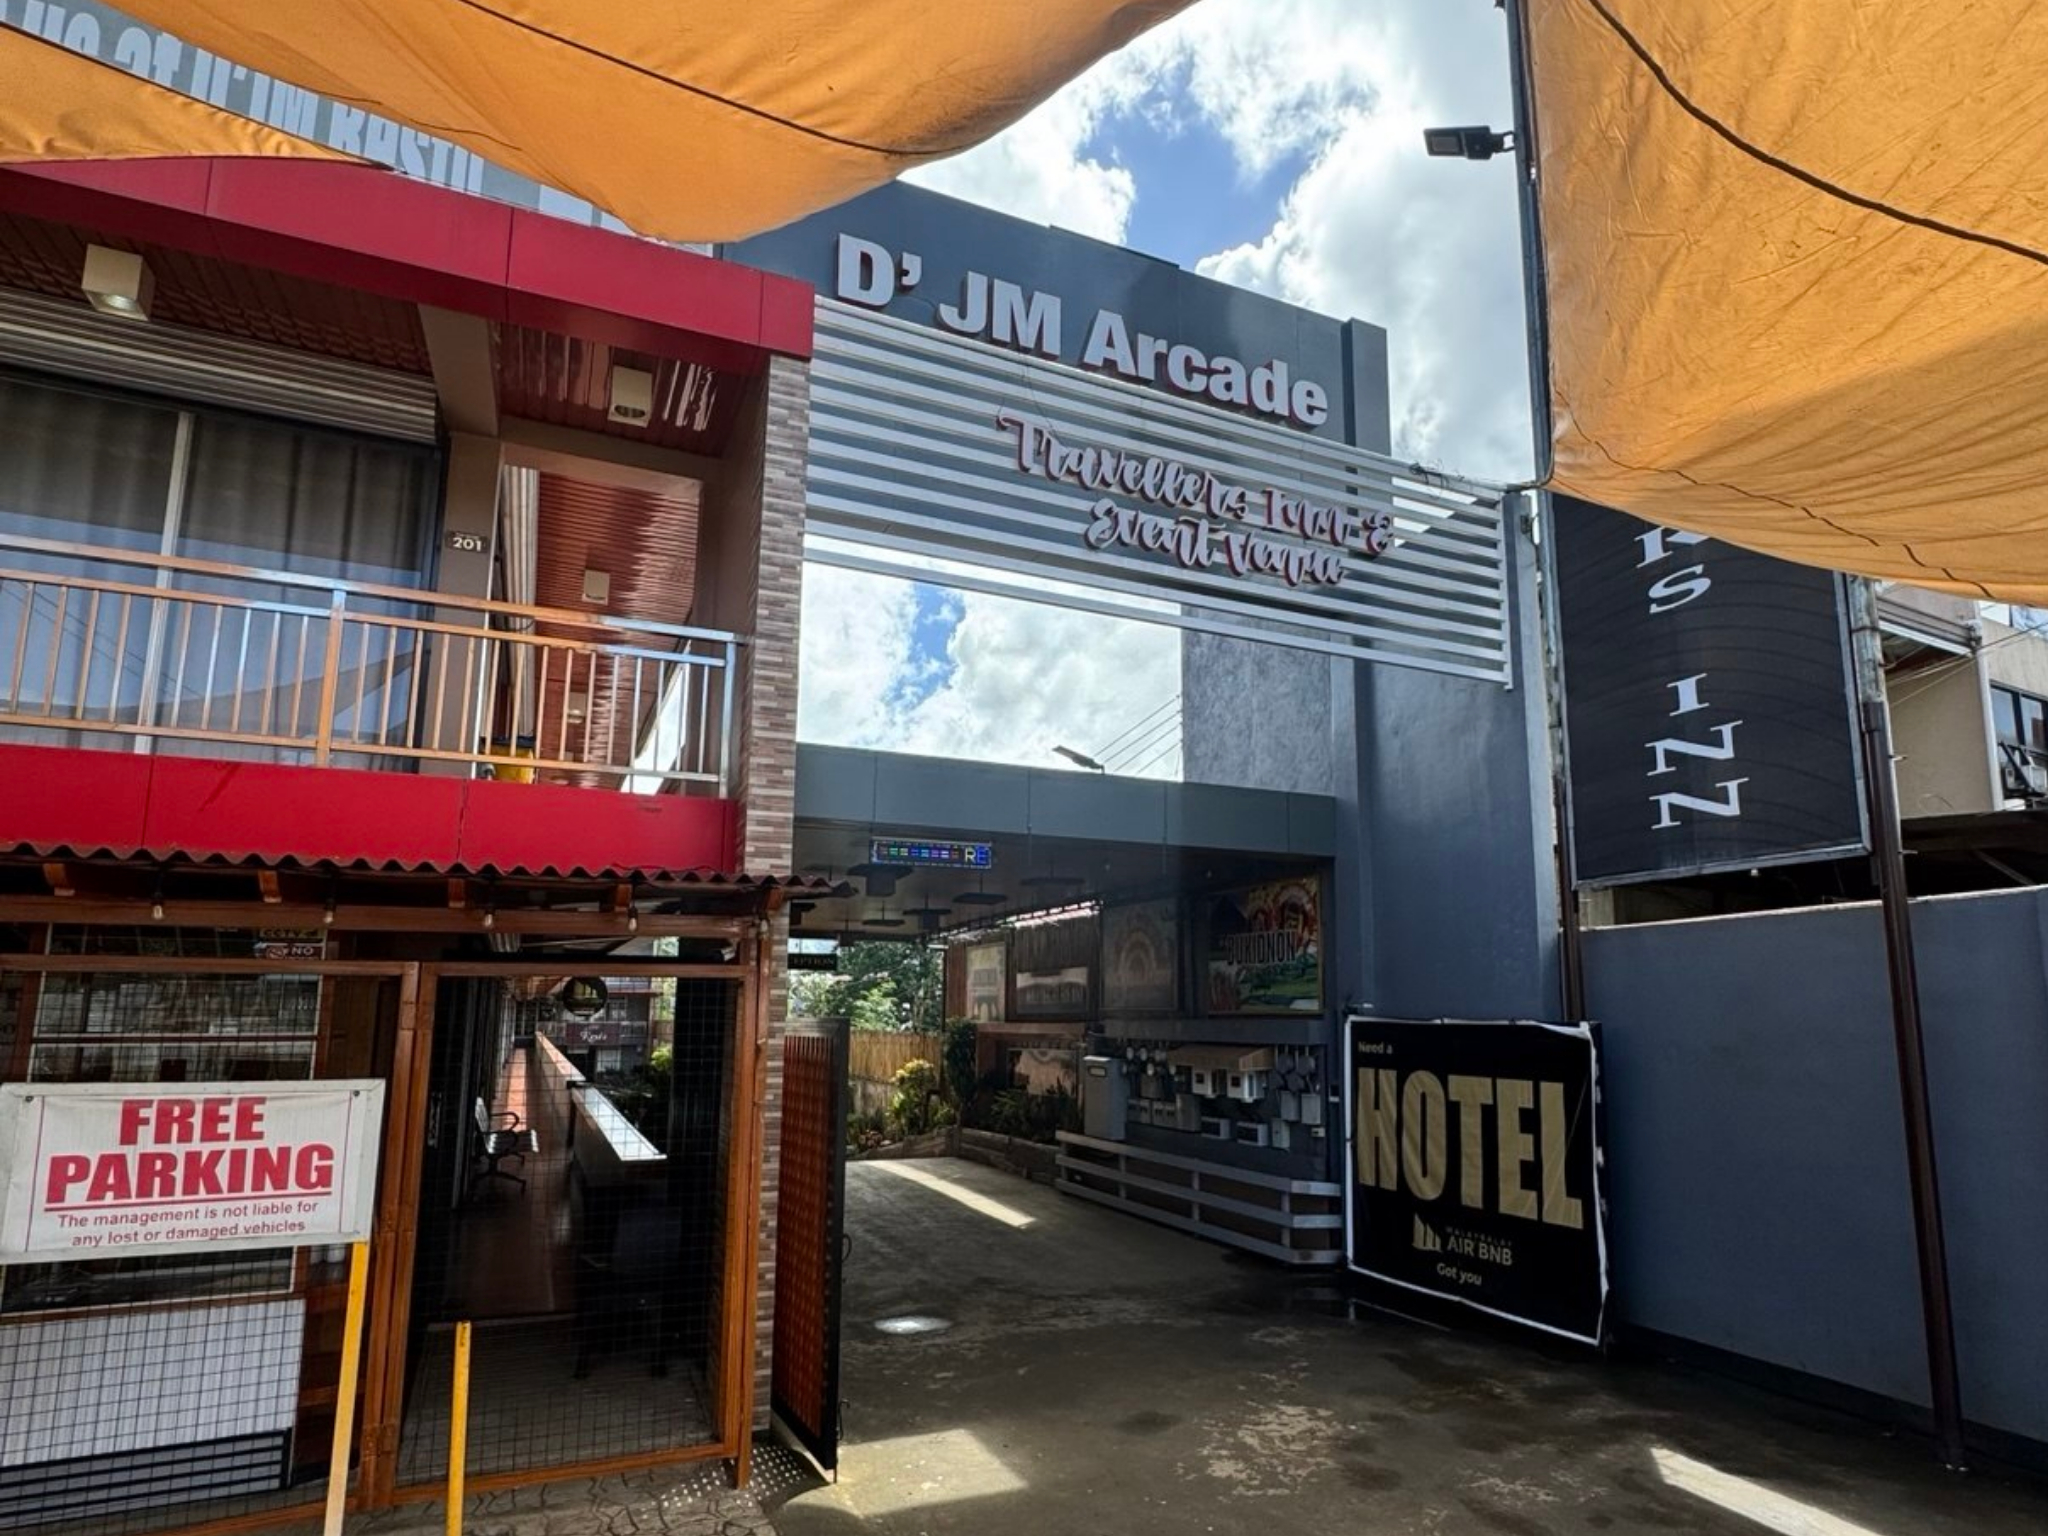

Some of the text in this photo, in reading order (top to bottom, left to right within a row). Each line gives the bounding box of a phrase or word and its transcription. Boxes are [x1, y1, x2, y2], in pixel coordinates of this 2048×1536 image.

[837, 232, 1330, 430] D' JM Arcade
[996, 414, 1249, 520] Travellers
[453, 537, 482, 552] 201
[1084, 497, 1348, 588] Event Venue
[291, 947, 314, 956] NO
[1357, 1041, 1394, 1055] Need a
[119, 1096, 268, 1146] FREE
[1357, 1067, 1584, 1229] HOTEL
[45, 1143, 335, 1204] PARKING
[58, 1201, 320, 1229] The management is not liable for
[72, 1218, 306, 1247] any lost or damaged vehicles
[1447, 1234, 1513, 1266] AIR BNB
[1436, 1262, 1482, 1287] Got you
